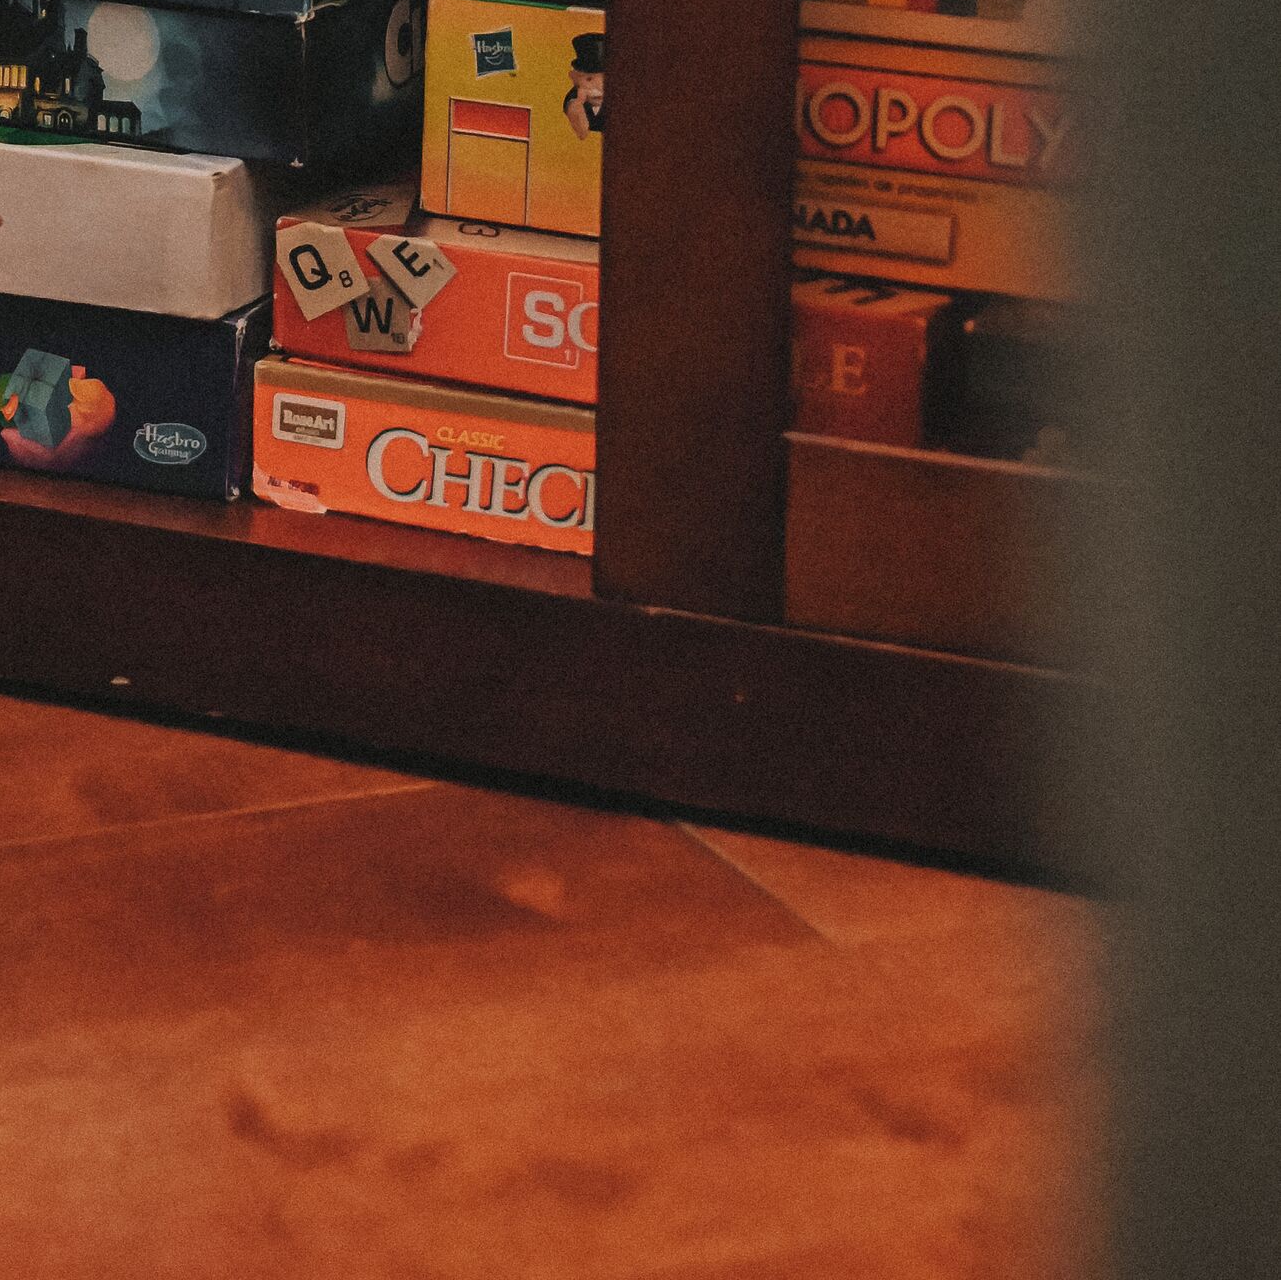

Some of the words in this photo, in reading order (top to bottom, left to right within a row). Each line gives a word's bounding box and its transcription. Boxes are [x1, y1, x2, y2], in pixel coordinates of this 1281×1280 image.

[806, 80, 1067, 168] OPOLY
[288, 243, 333, 291] Q
[338, 269, 354, 289] 8
[391, 239, 431, 278] E
[349, 296, 395, 335] W
[137, 424, 201, 449] Hasbro
[436, 426, 505, 450] CLASSIC
